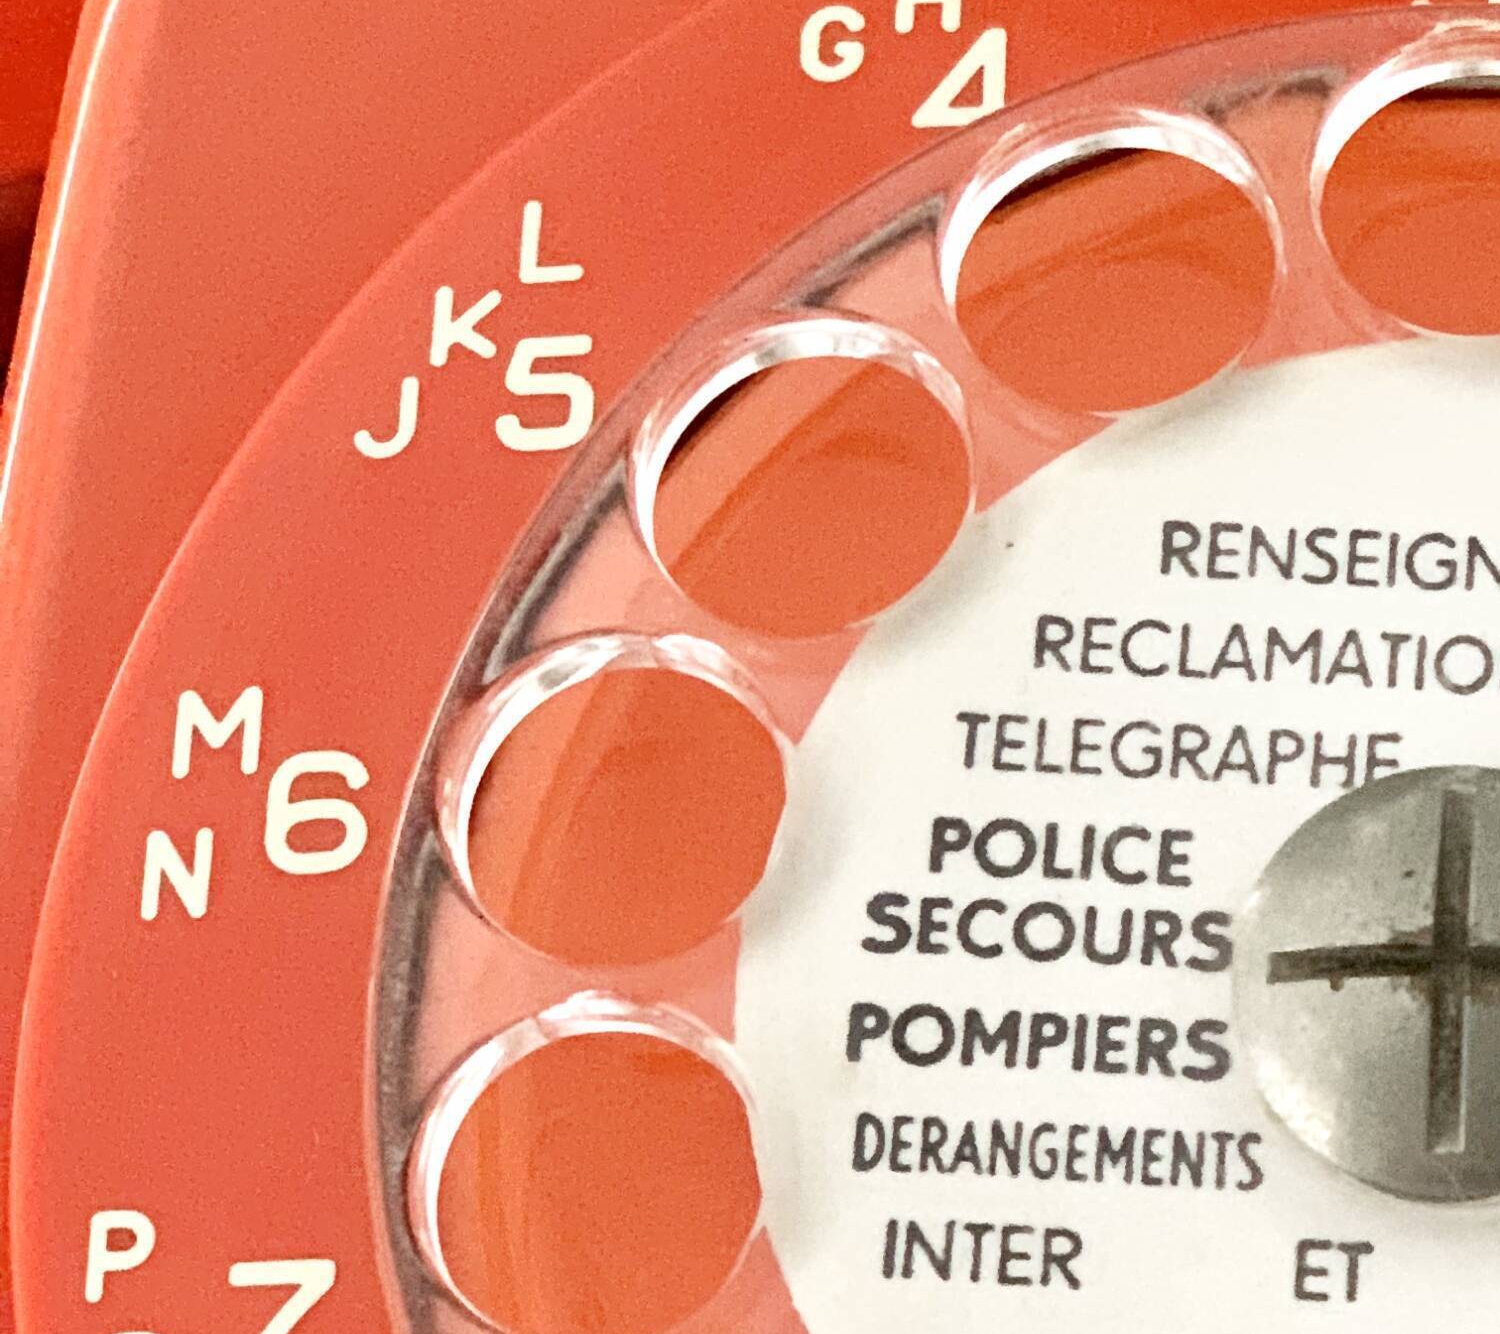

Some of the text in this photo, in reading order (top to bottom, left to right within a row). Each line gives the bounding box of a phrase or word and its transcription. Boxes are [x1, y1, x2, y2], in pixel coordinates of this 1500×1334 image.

[911, 27, 1007, 128] 4
[494, 334, 594, 452] 5
[956, 711, 1404, 788] TELEGRAPHE
[264, 751, 369, 874] 6
[929, 816, 1193, 887] POLICE
[861, 892, 1233, 972] SECOURS
[846, 1003, 1230, 1082] POMPIERS
[852, 1112, 1264, 1191] DERANGEMENTS
[883, 1219, 1082, 1290] INTER
[1294, 1239, 1374, 1302] ET
